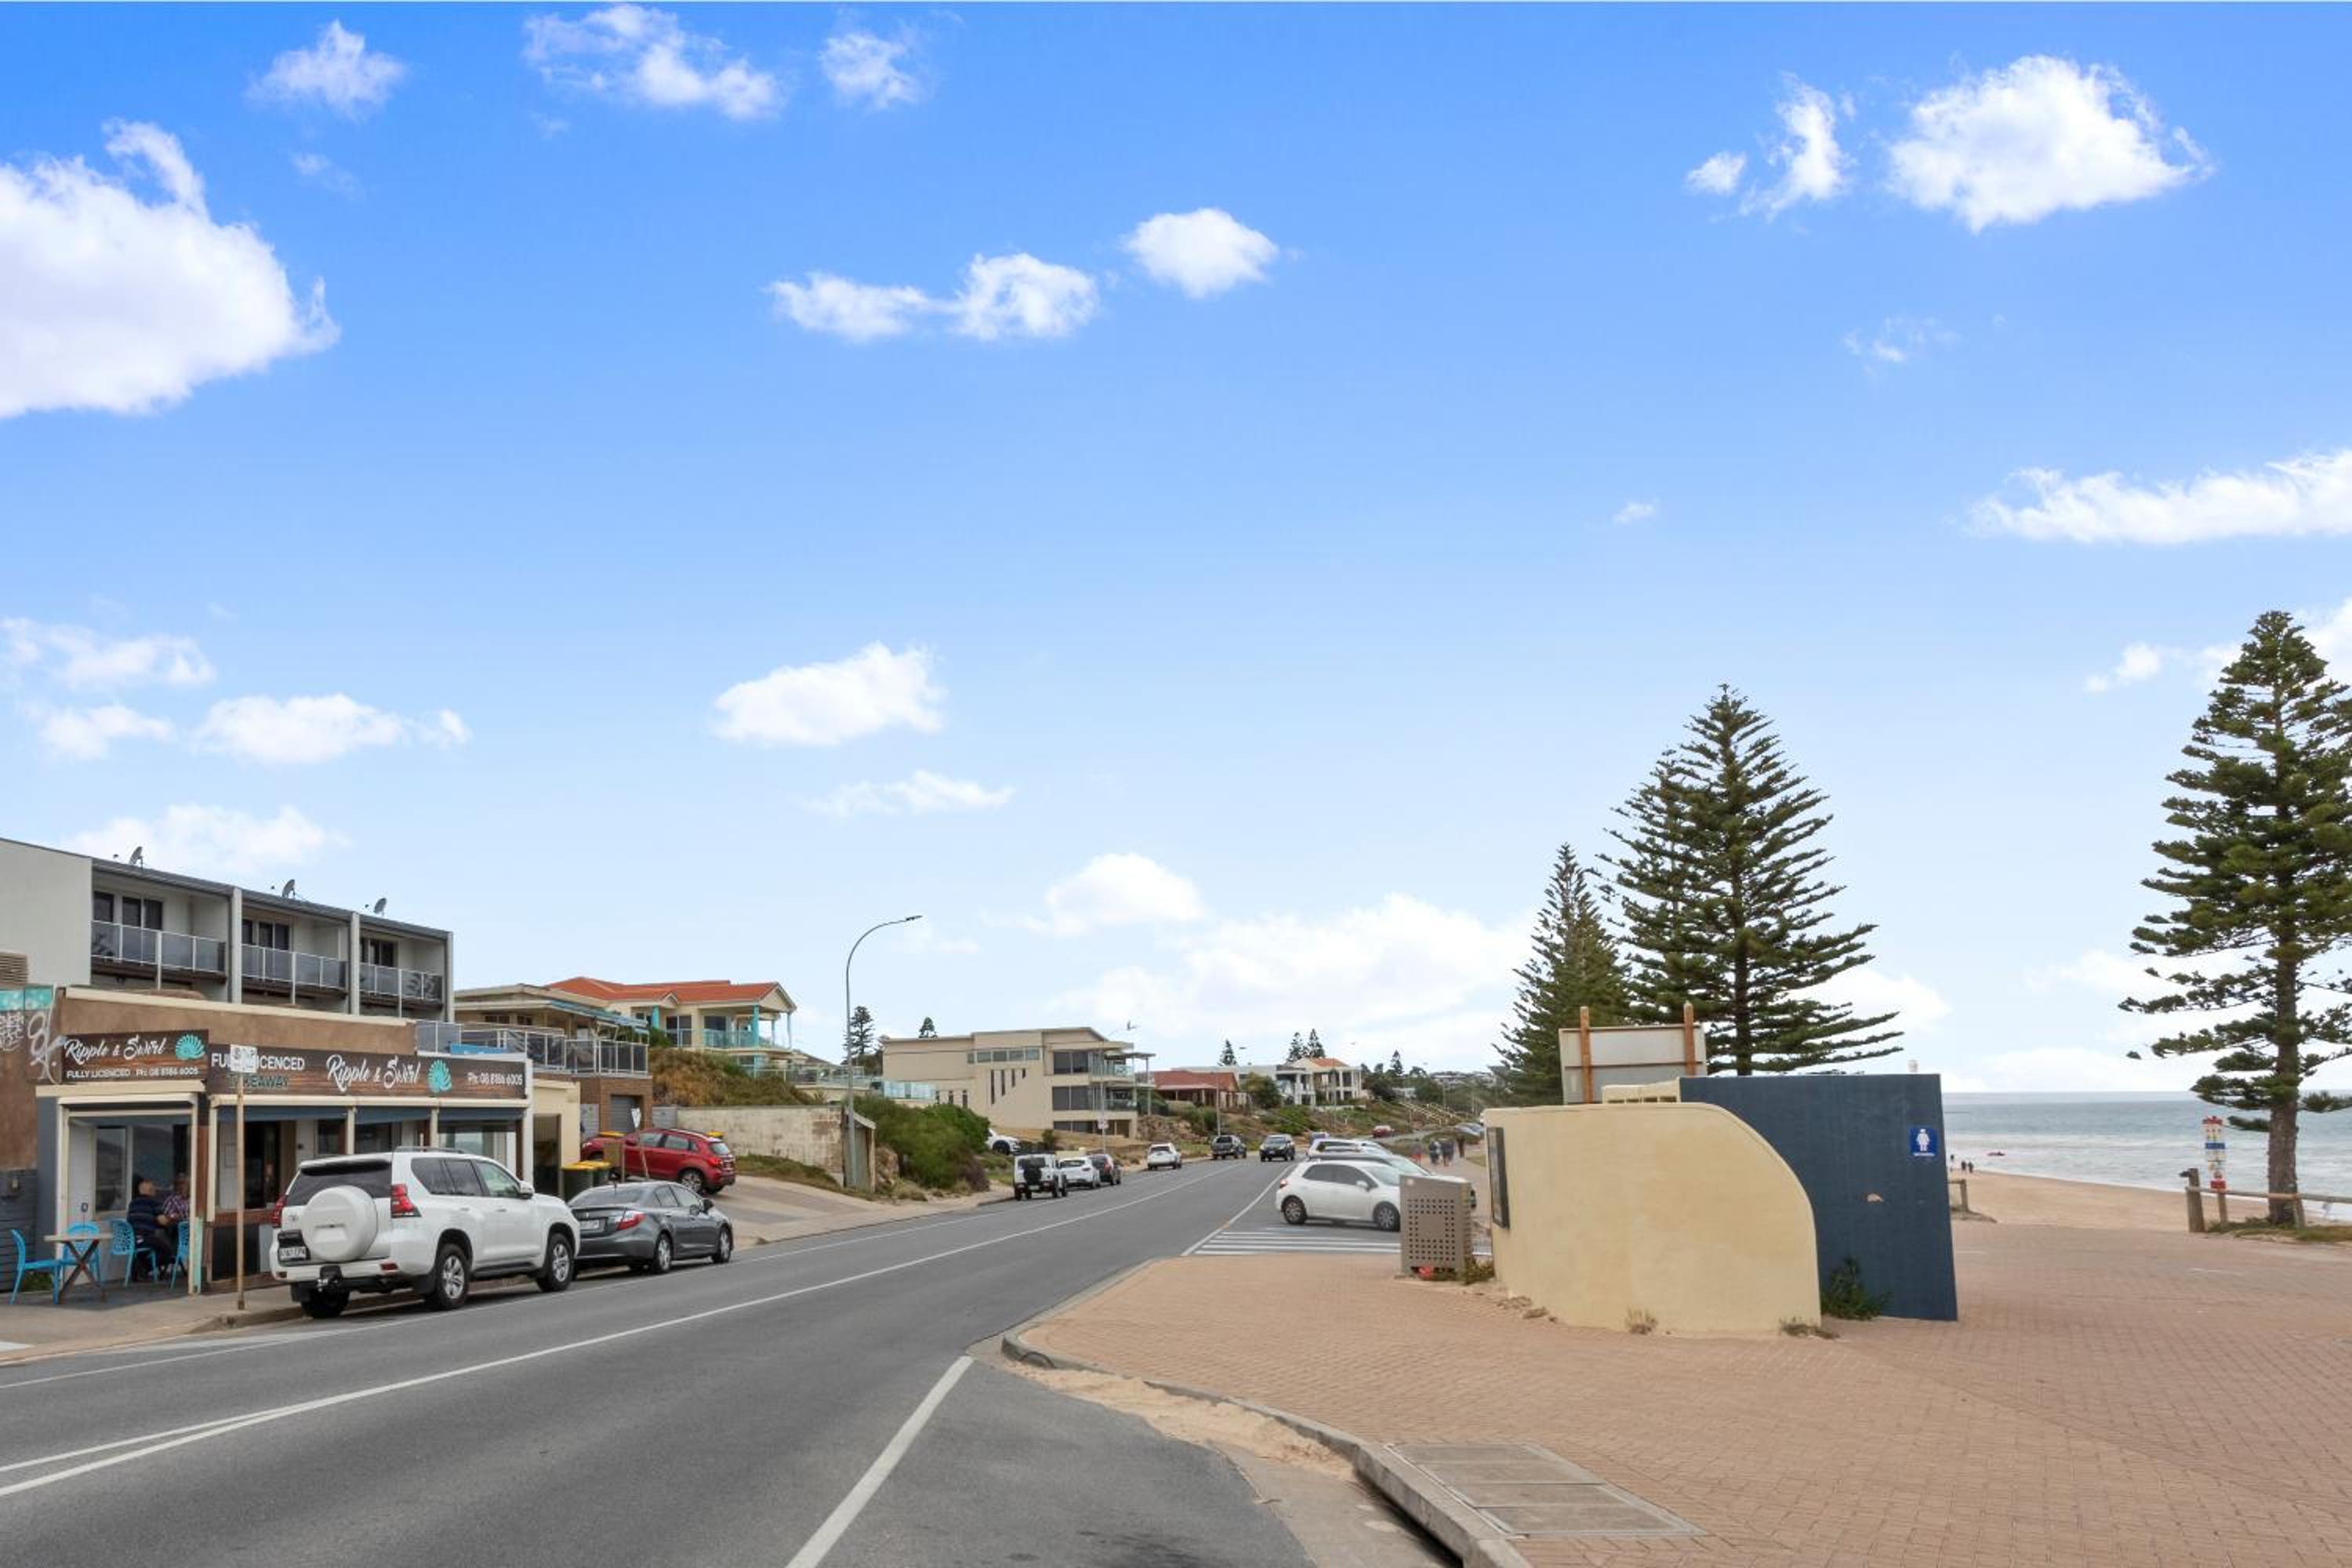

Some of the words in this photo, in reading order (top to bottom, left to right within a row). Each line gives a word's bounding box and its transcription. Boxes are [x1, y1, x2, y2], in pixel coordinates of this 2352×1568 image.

[64, 1038, 108, 1065] Ripple
[112, 1044, 121, 1056] &
[123, 1034, 166, 1060] Swirl
[256, 1054, 305, 1070] ICENCED
[67, 1070, 89, 1079] FULLY
[91, 1069, 131, 1078] LICENCED
[179, 1066, 199, 1076] 6005
[227, 1073, 289, 1087] TKEAWAY
[326, 1054, 370, 1092] Ripple
[373, 1067, 381, 1082] &
[383, 1055, 421, 1089] Swirl
[506, 1073, 523, 1086] 6005
